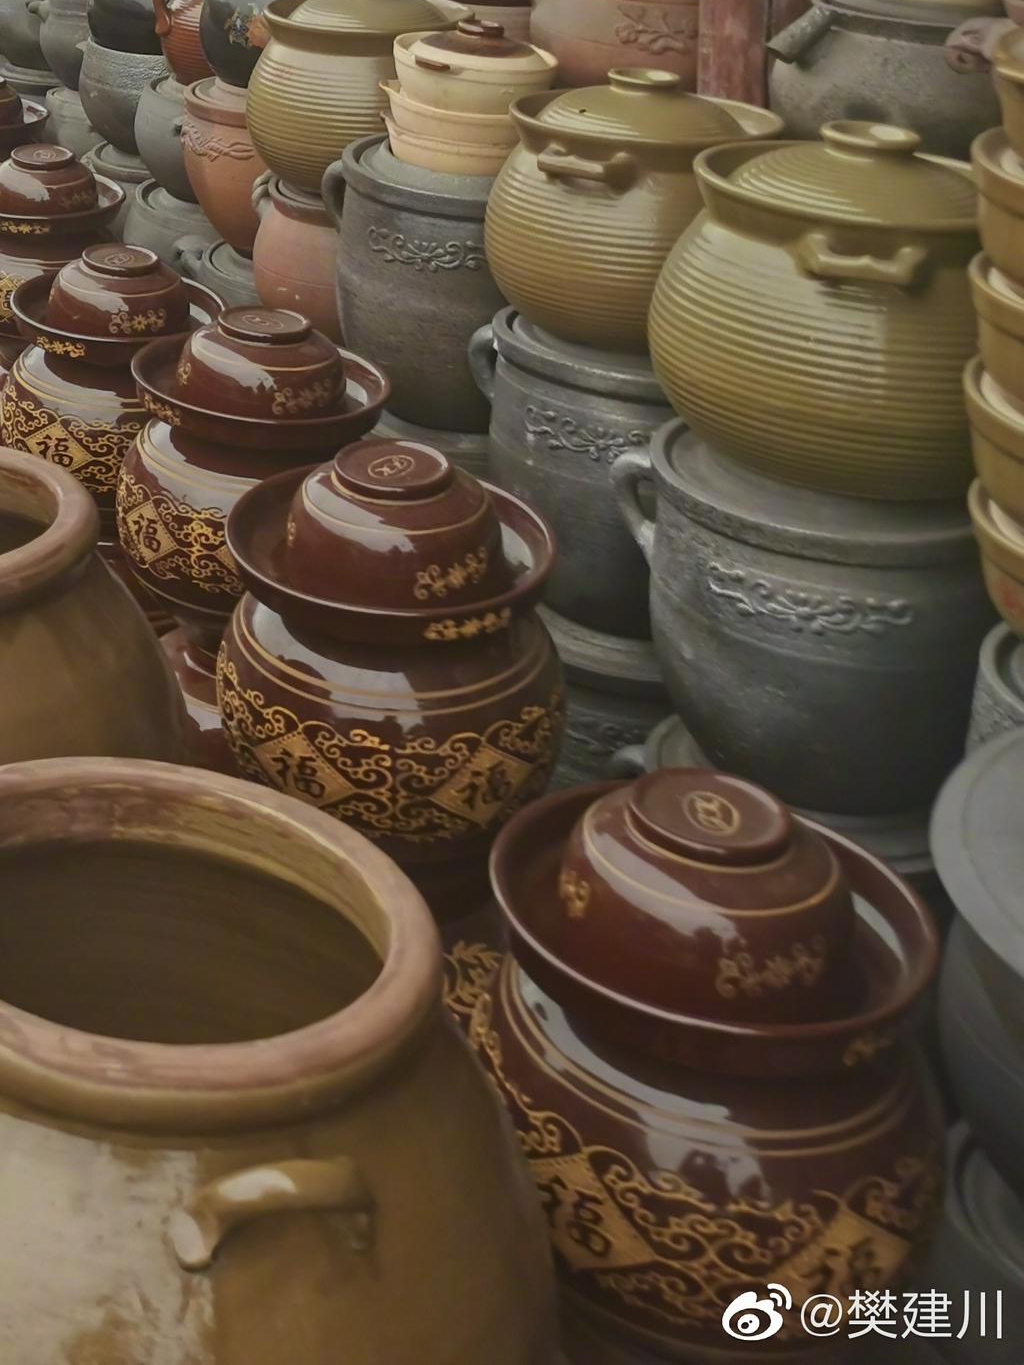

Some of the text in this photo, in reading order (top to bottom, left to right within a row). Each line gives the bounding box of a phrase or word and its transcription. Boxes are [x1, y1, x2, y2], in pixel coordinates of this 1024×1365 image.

[36, 434, 74, 468] 福
[132, 513, 162, 554] 福
[270, 747, 327, 799] 福
[450, 760, 513, 811] 福
